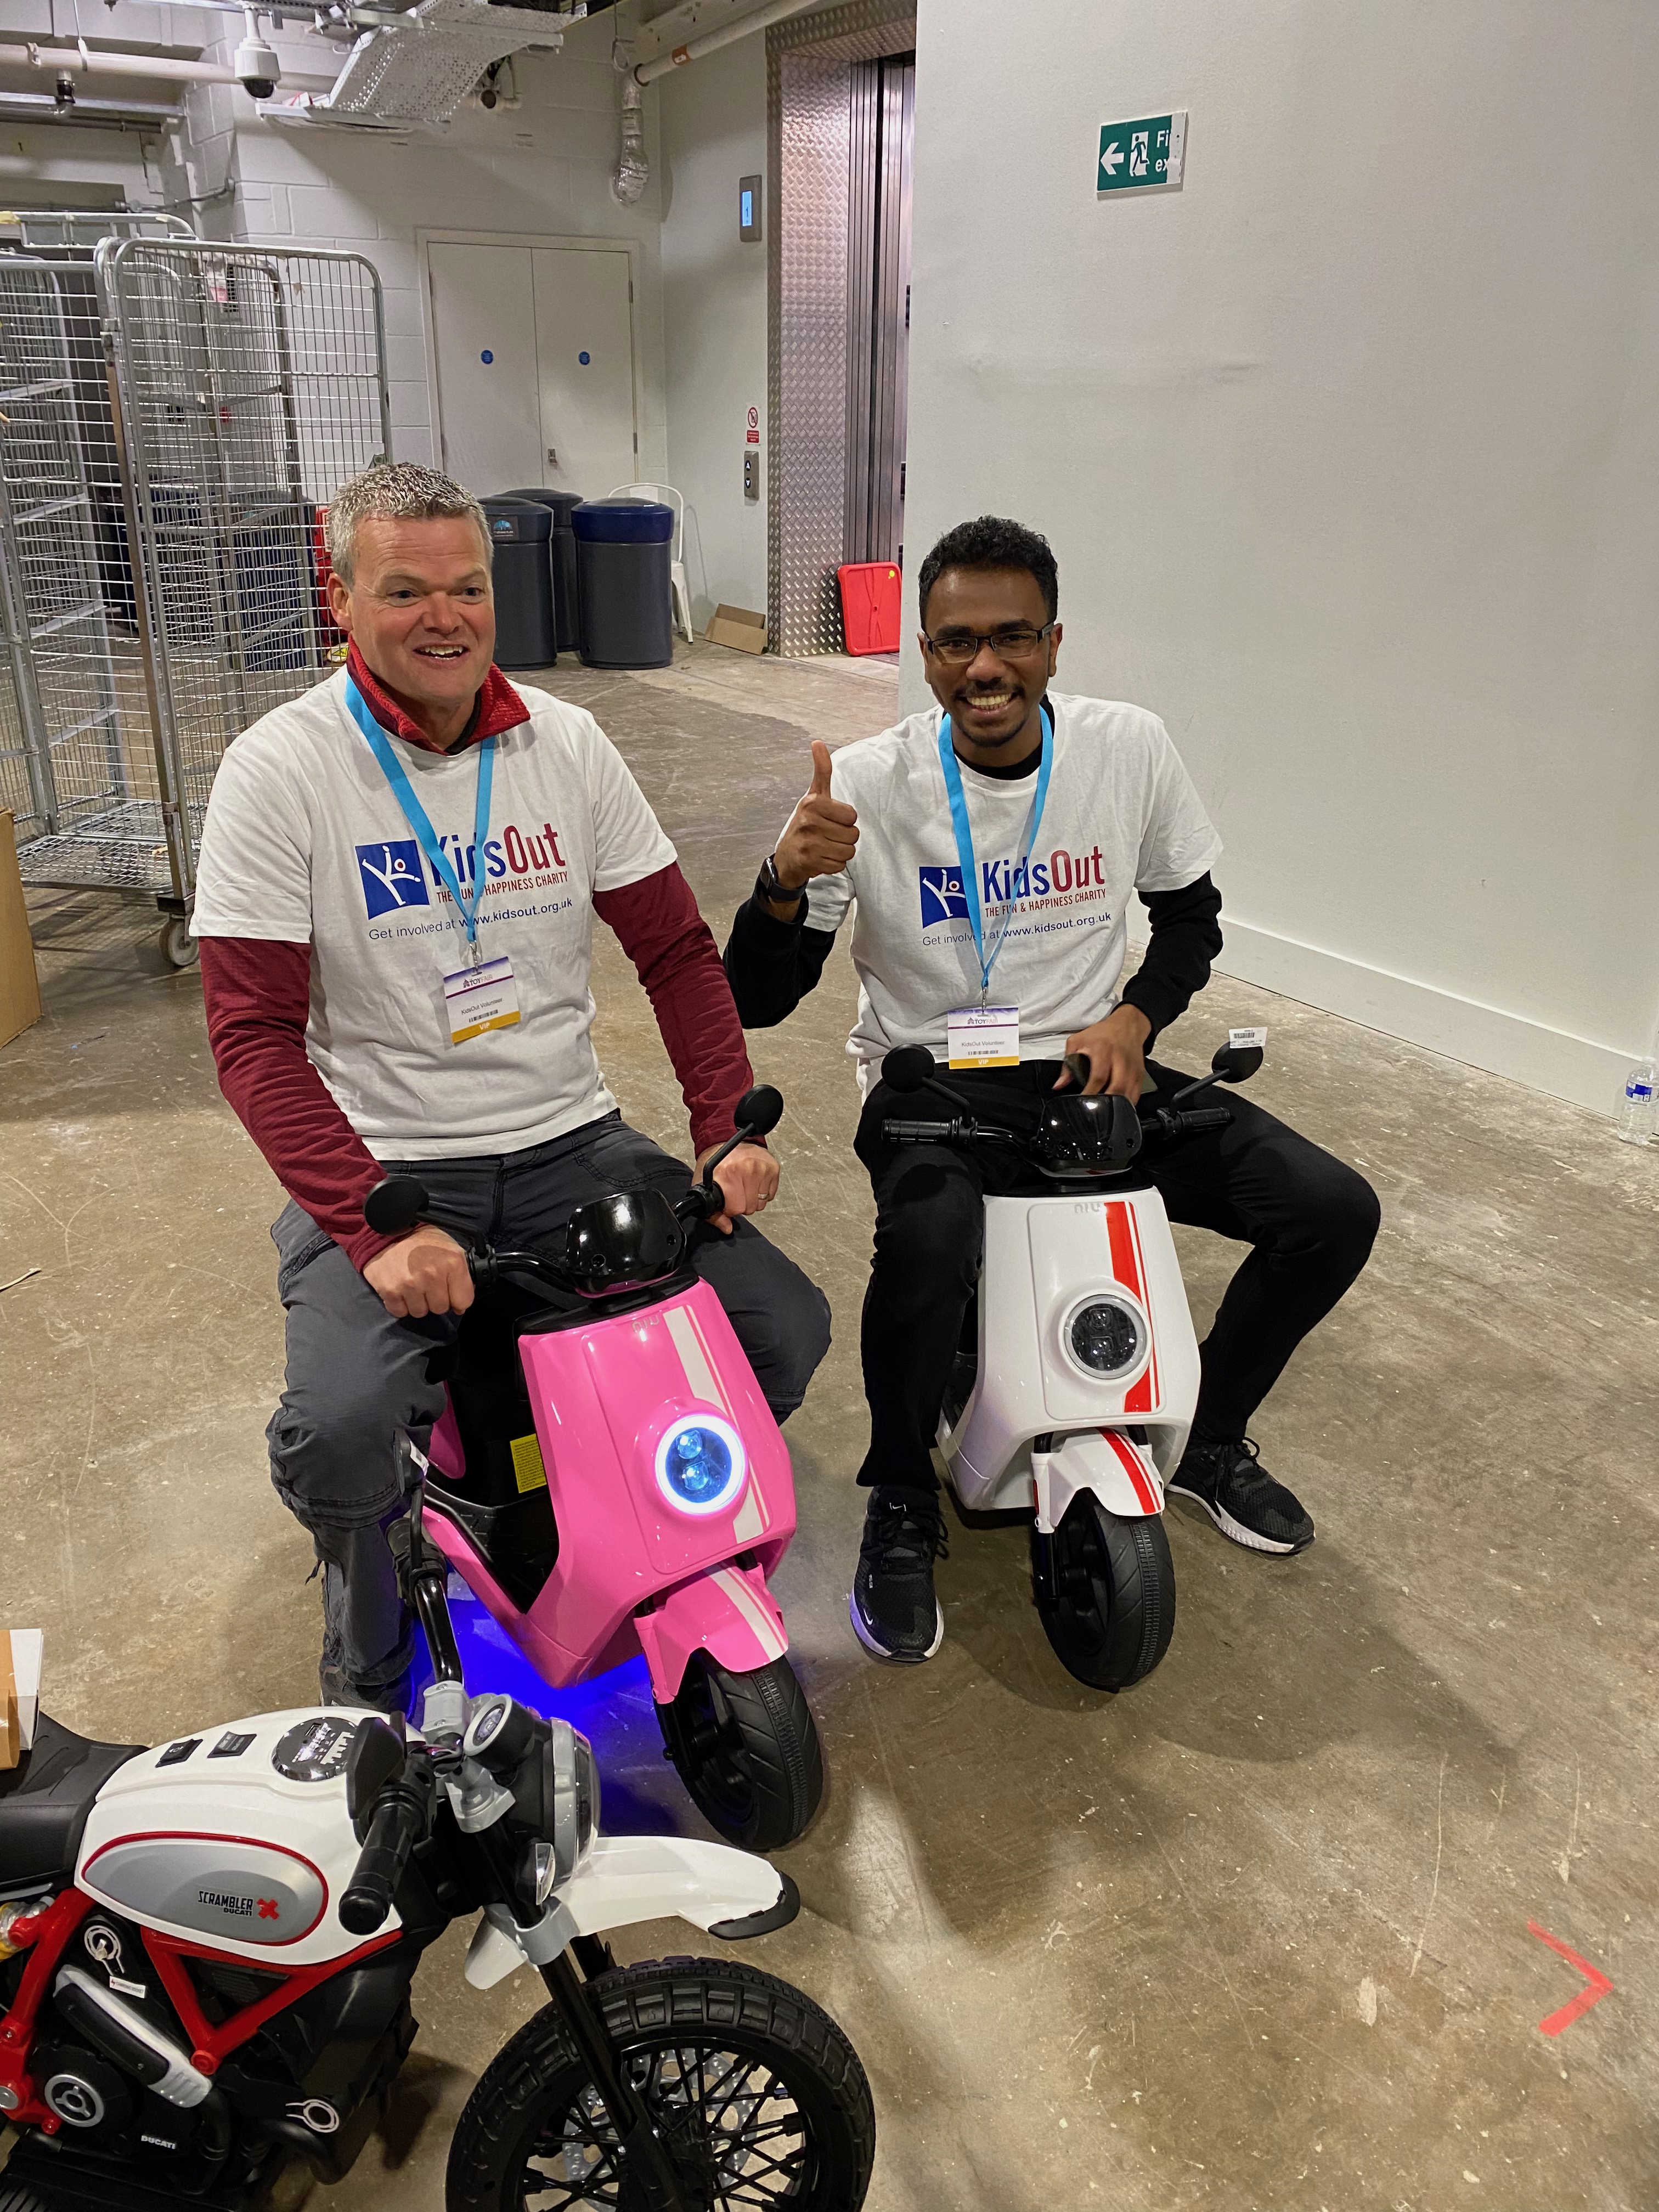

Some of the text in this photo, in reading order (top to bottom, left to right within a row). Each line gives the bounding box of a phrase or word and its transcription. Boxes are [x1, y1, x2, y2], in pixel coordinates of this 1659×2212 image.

[437, 890, 453, 904] THE
[461, 887, 474, 900] UN
[484, 878, 534, 895] HAPPINESS
[536, 871, 568, 887] CHARITY
[982, 845, 1105, 903] KidsOut
[985, 888, 1106, 918] THE FUN & HAPPINESS CHARITY
[369, 897, 573, 940] Get involved at www.kidsout.org.uk
[922, 935, 941, 945] Get
[990, 929, 1000, 939] at
[1003, 912, 1111, 938] www.kidsout.org.uk
[479, 1022, 490, 1030] VIP
[198, 1891, 253, 1910] SCRAMBLER
[223, 1908, 252, 1916] DUCATI
[141, 2135, 176, 2149] DUCATI
